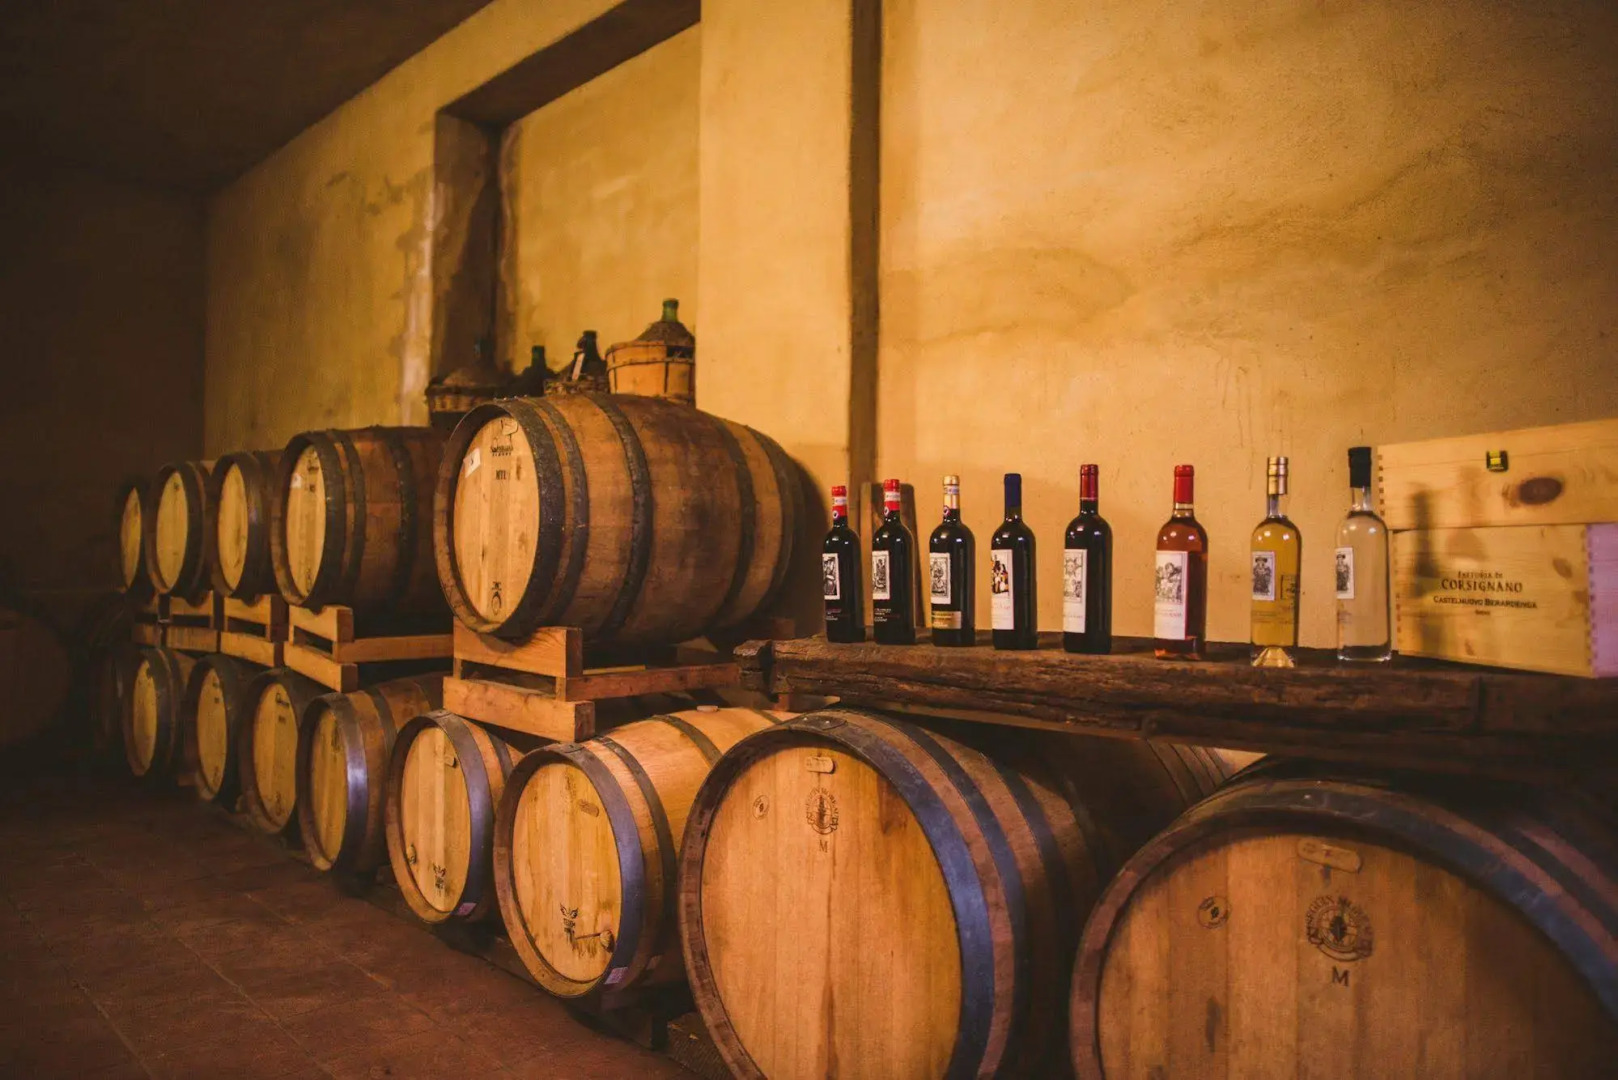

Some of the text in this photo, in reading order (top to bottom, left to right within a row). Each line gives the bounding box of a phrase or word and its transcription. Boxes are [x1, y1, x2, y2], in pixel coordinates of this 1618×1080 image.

[1441, 579, 1523, 593] CORSIGNANO
[1433, 595, 1537, 608] CASTELNUOVO BERARDENGA
[1332, 966, 1350, 987] M
